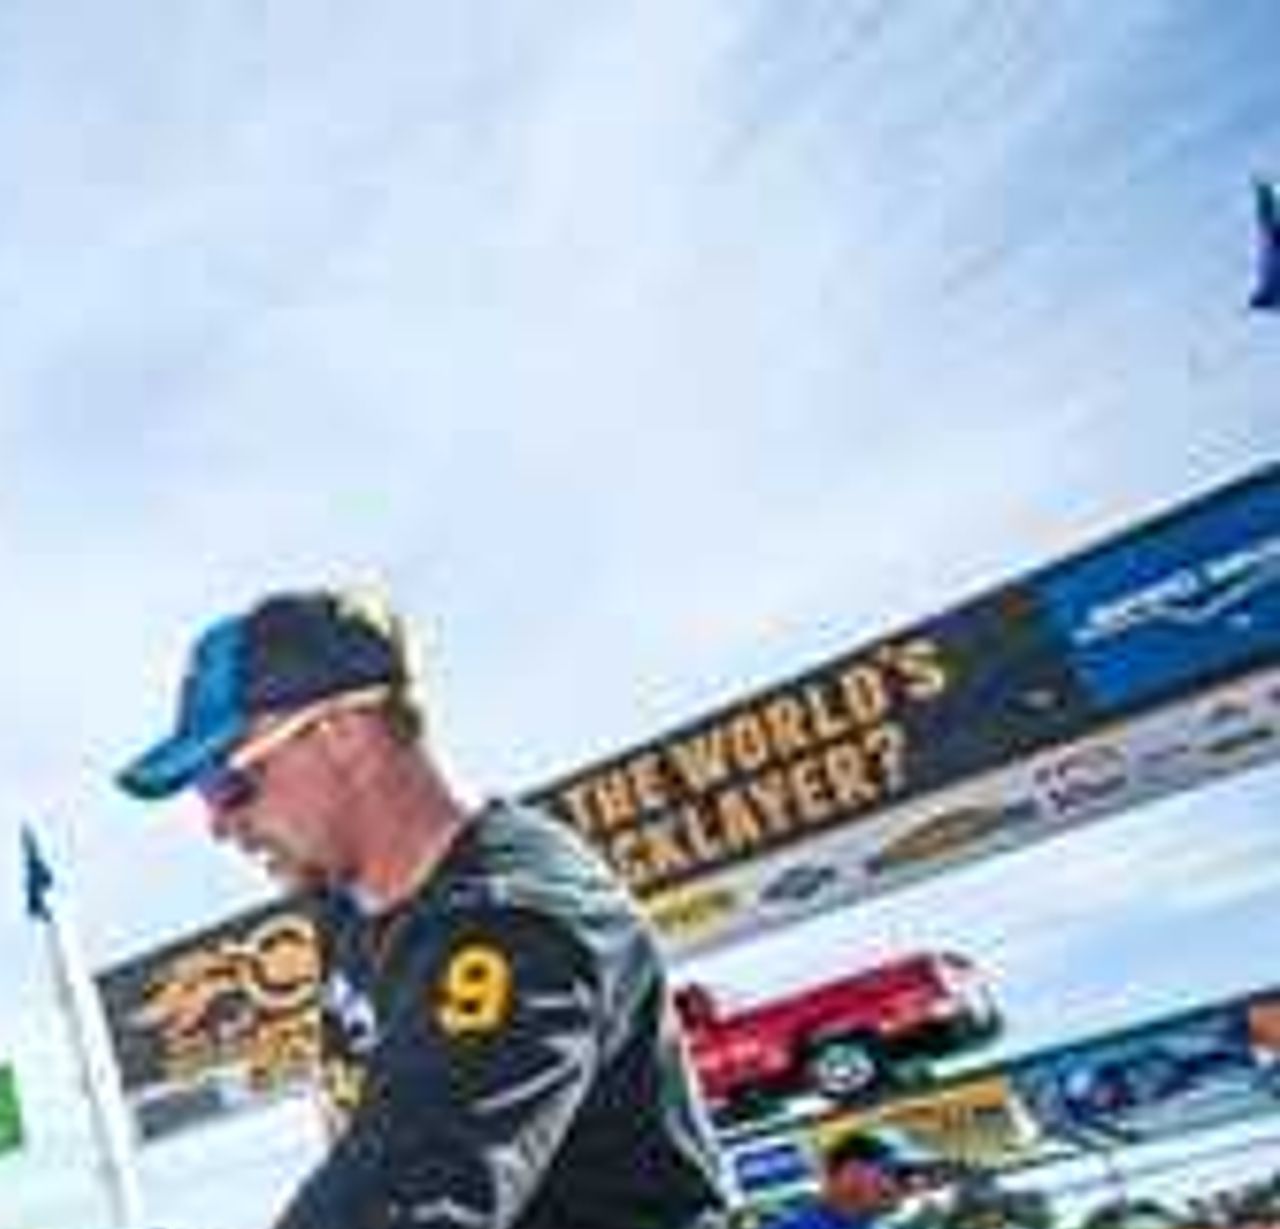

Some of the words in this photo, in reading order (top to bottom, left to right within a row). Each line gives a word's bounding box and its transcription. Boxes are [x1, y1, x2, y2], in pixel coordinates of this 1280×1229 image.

[563, 752, 674, 834] THE
[667, 638, 946, 791] WORLD'S
[439, 944, 513, 1036] 9
